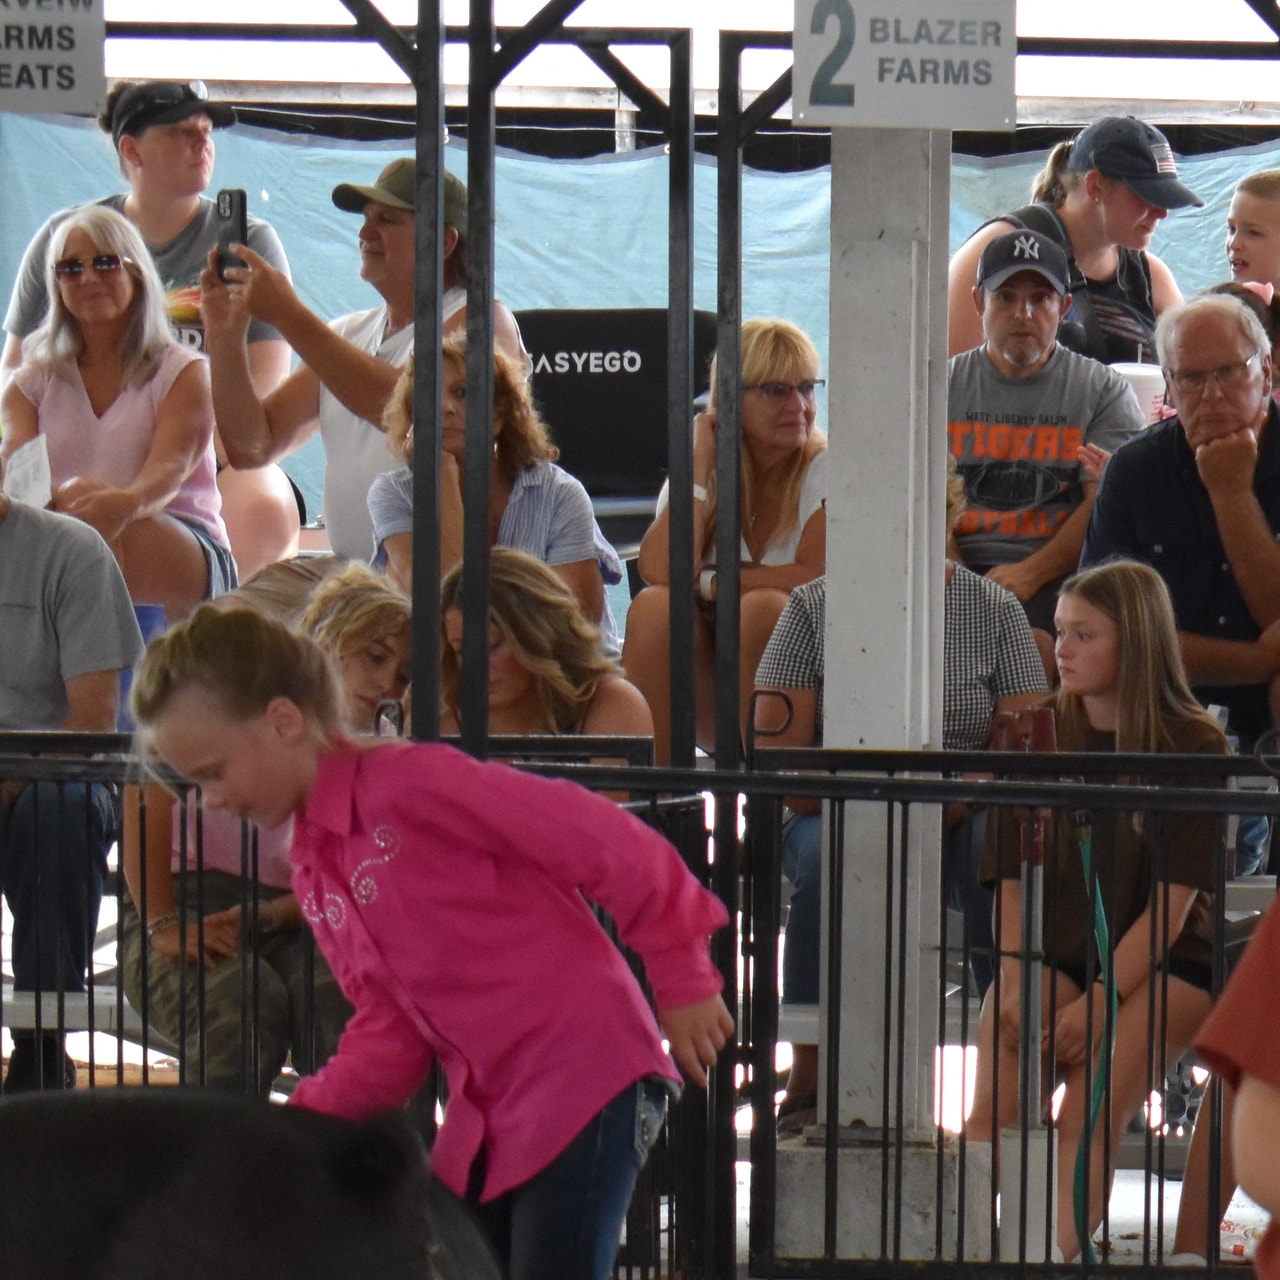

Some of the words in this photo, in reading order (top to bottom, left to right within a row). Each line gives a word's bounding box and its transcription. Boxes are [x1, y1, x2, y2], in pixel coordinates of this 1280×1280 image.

[0, 25, 76, 51] RMS
[869, 17, 1002, 47] BLAZER
[809, 0, 856, 107] 2
[878, 57, 993, 86] FARMS
[528, 350, 642, 374] ASYEGO
[947, 421, 1083, 461] TIGERS
